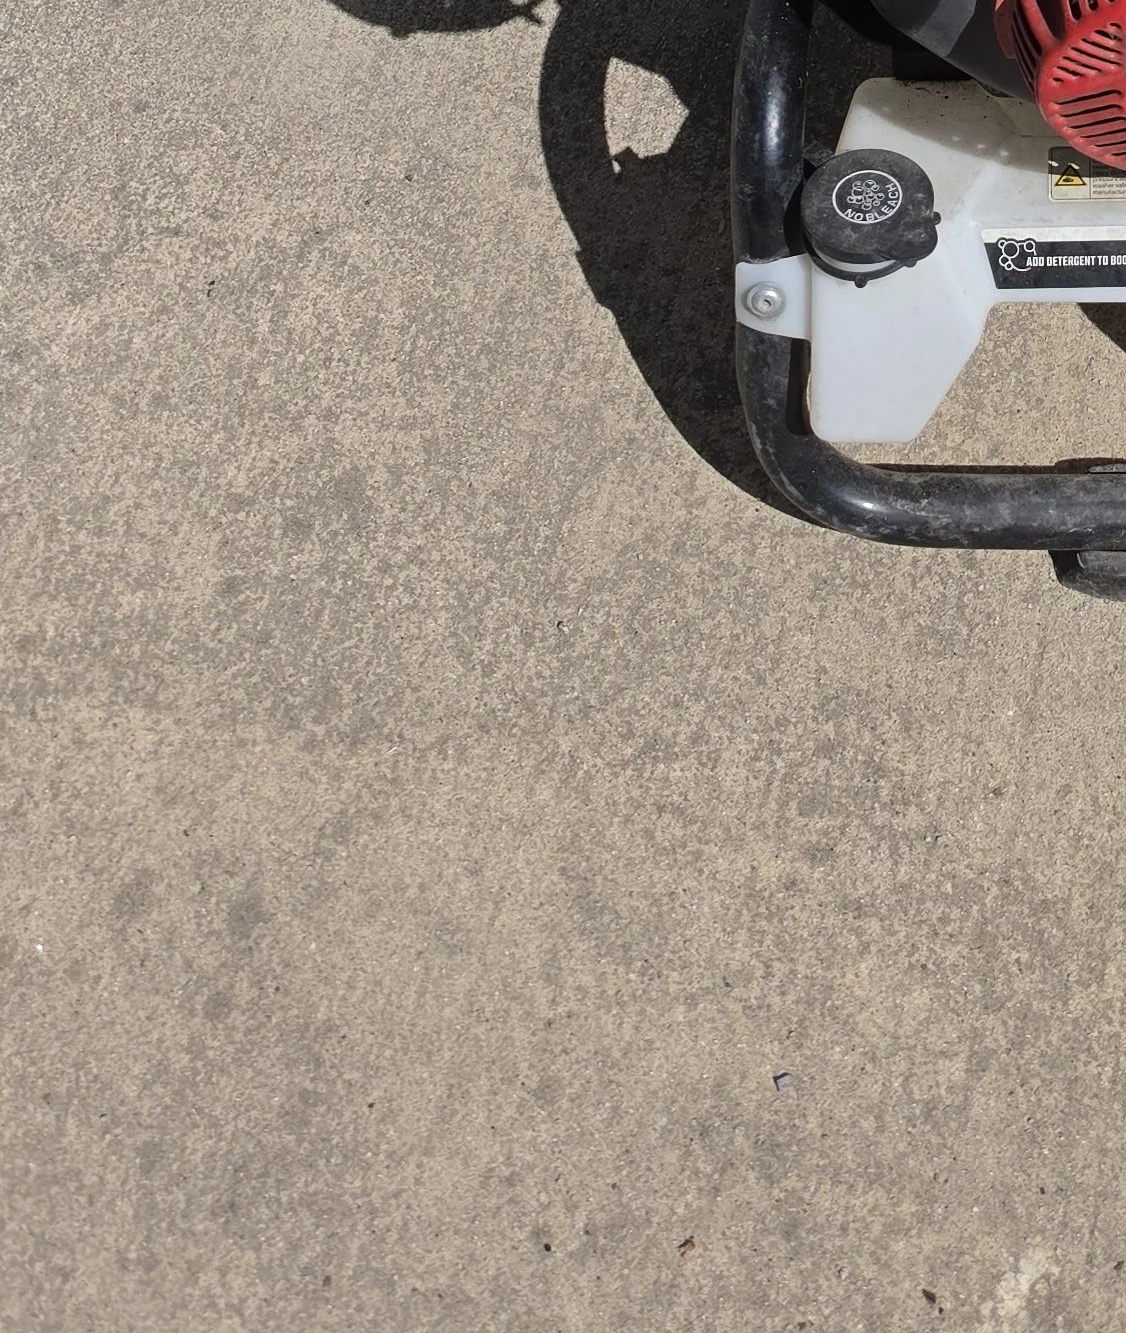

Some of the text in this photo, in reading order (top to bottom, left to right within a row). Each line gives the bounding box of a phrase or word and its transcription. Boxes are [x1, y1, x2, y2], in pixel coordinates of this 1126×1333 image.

[1026, 256, 1045, 267] ADD
[1046, 255, 1096, 267] DETERGENT
[1097, 255, 1109, 266] TO
